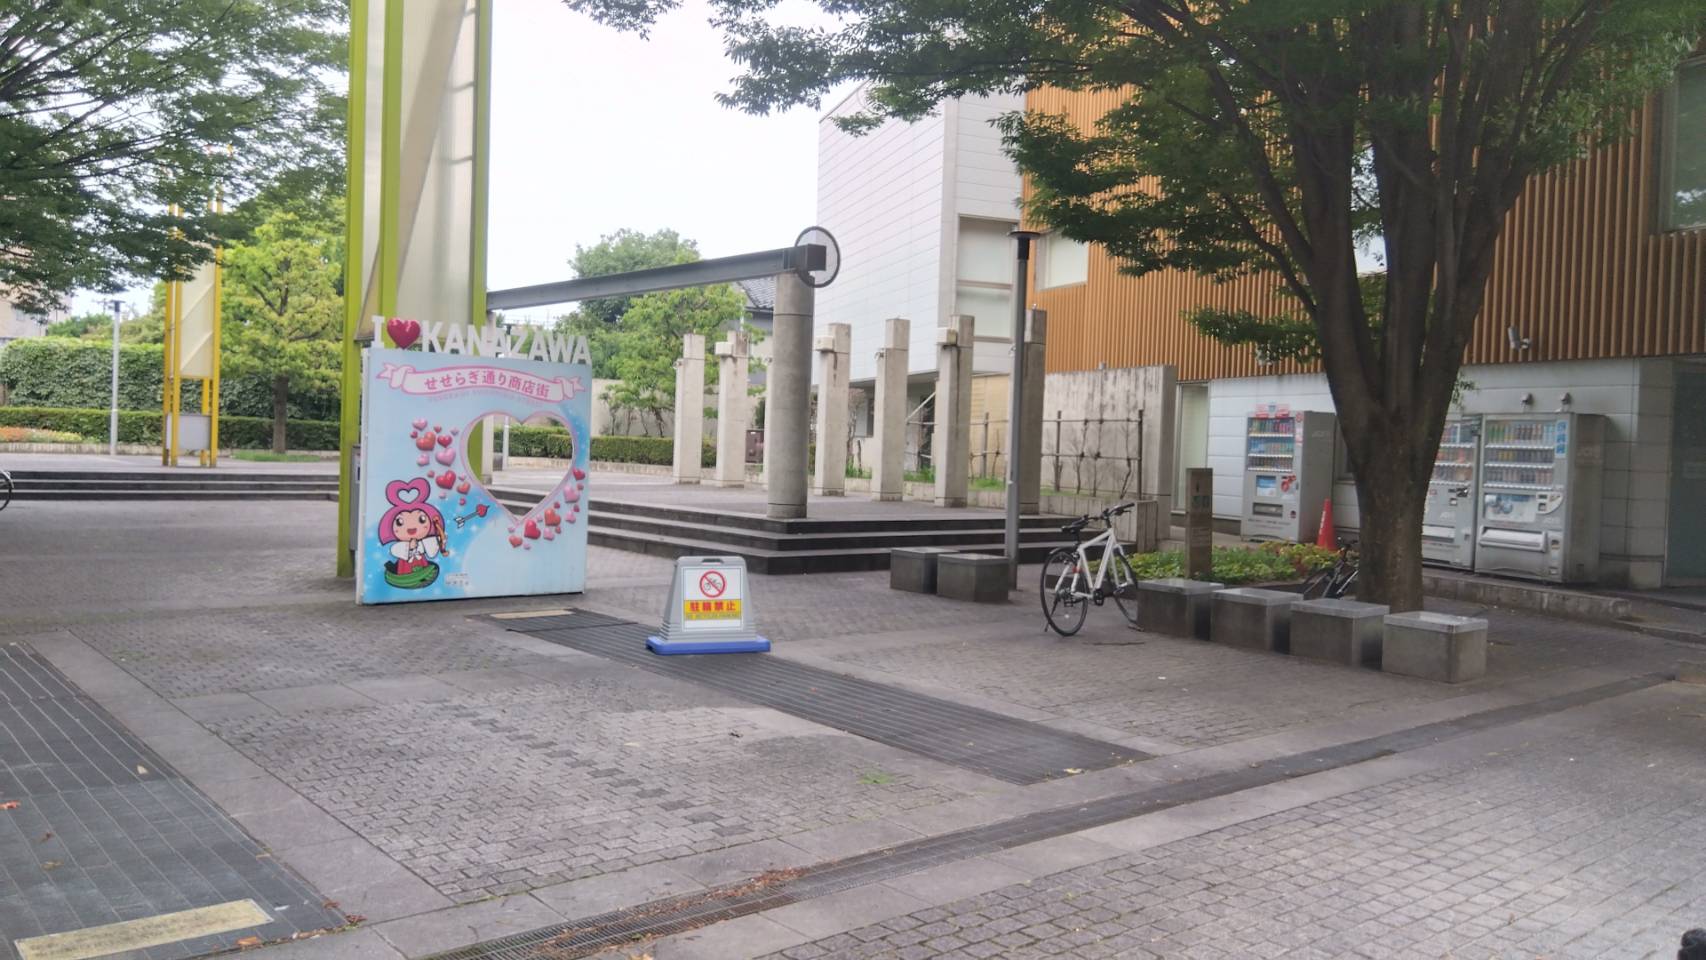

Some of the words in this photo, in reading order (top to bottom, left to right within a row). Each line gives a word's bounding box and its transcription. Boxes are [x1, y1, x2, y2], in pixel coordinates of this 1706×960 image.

[371, 316, 386, 350] I
[422, 321, 592, 365] KANAZAWA
[425, 371, 550, 398] せせらぎ通り商店街
[690, 600, 737, 612] 駐輪禁止
